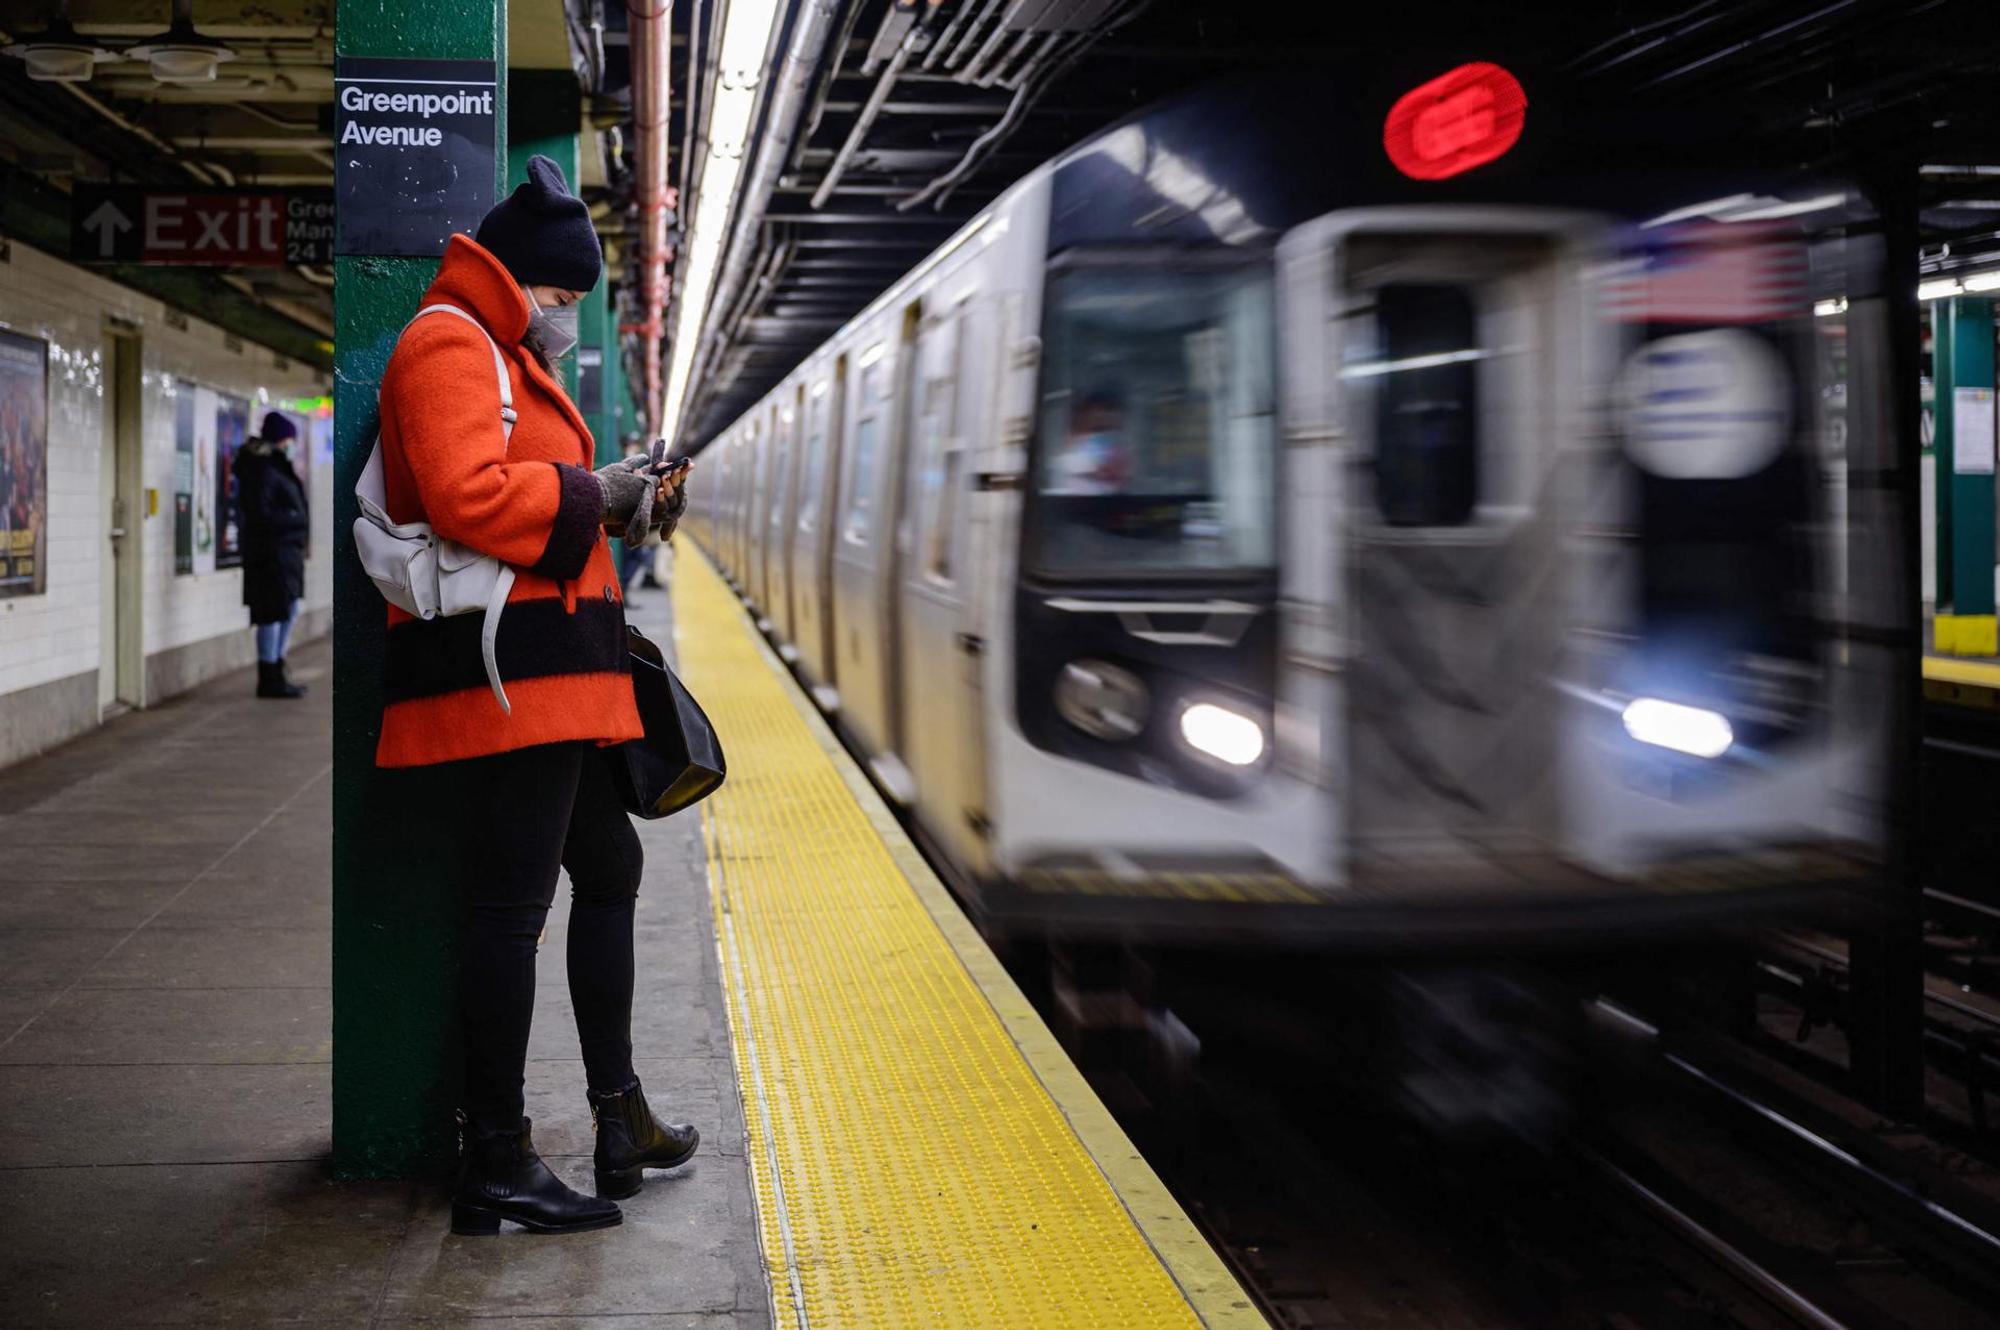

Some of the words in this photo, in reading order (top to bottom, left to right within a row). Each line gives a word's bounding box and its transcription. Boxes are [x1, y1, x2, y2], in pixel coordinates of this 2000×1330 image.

[341, 86, 493, 118] Greenpoint
[341, 120, 442, 146] Avenue
[144, 196, 280, 252] Exit
[287, 241, 316, 261] 24
